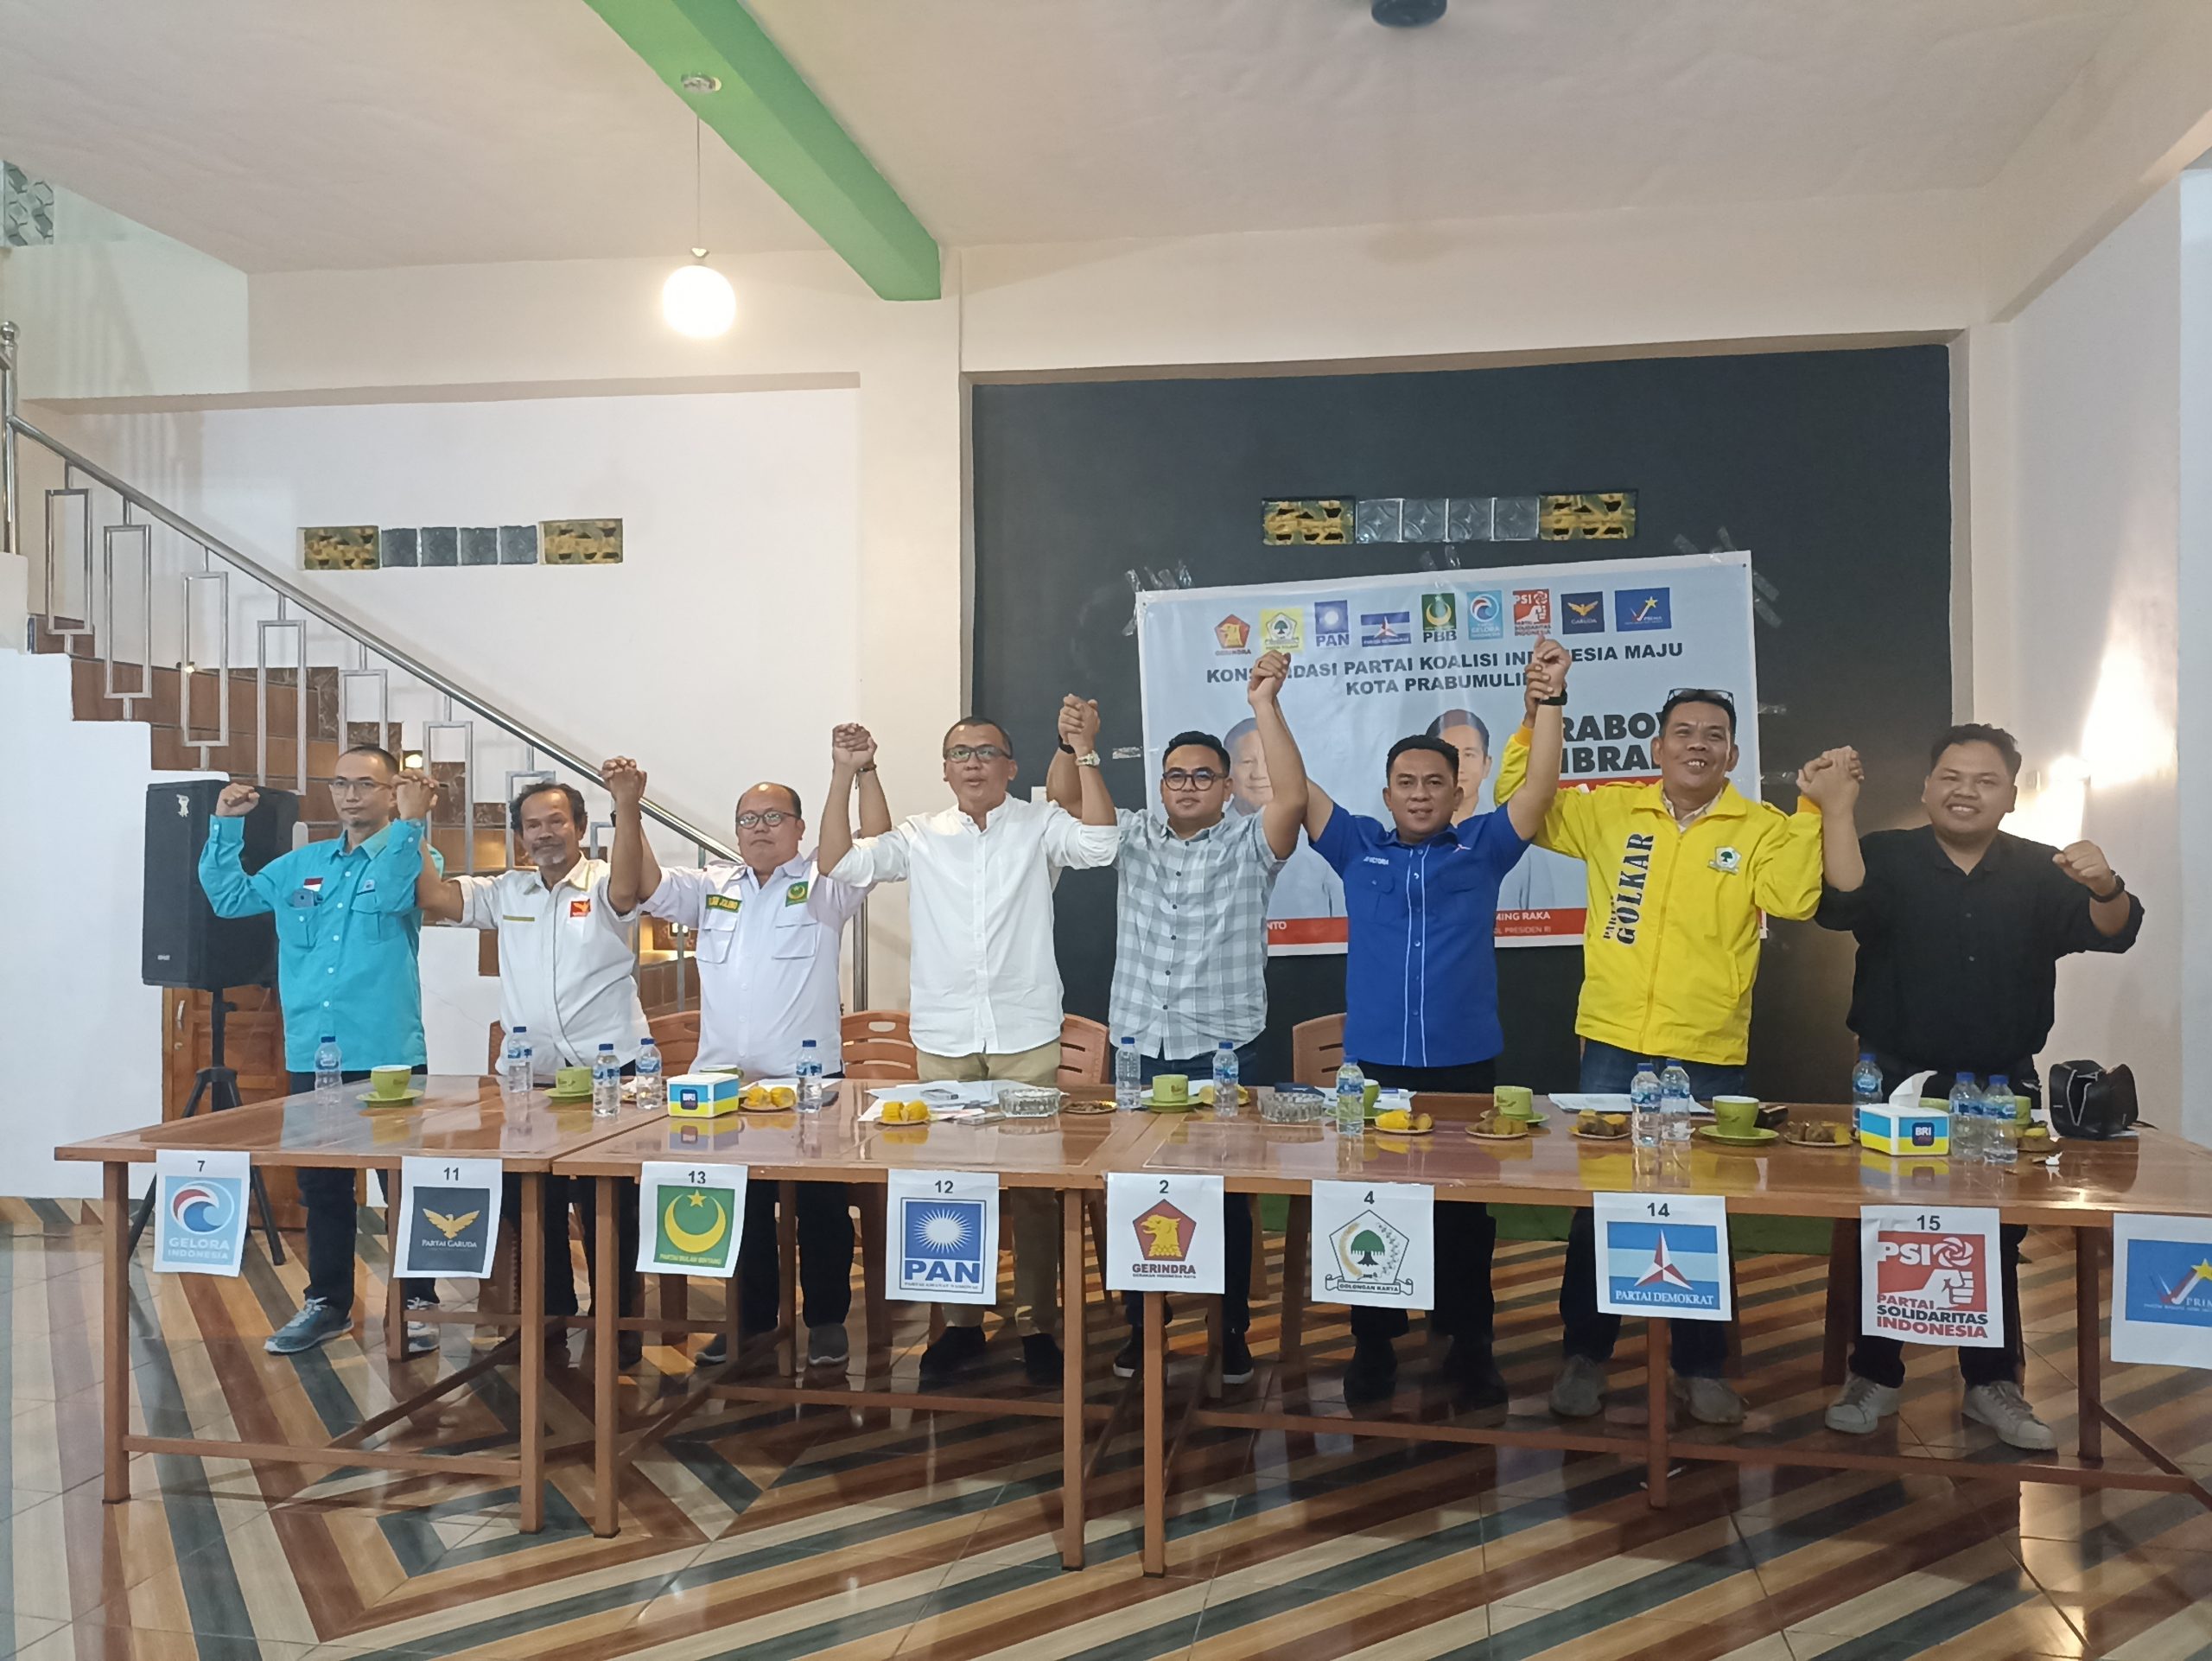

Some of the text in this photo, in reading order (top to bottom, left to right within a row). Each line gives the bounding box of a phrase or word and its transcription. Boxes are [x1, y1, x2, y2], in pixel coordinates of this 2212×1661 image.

[1316, 634, 1350, 647] PAN
[1423, 630, 1458, 643] PBB
[1207, 642, 1683, 684] KONDASI PARTAI KOALISI INESIA MAJU
[1346, 679, 1400, 696] KOTA
[1562, 712, 1662, 742] RABO
[1560, 744, 1662, 774] IBRA
[1617, 833, 1654, 945] GOLKAR
[1522, 911, 1551, 920] RAKA
[1915, 1126, 1932, 1136] BRI
[197, 1160, 206, 1173] 7
[443, 1167, 460, 1181] 11
[689, 1170, 707, 1184] 13
[934, 1180, 954, 1194] 12
[1159, 1179, 1169, 1194] 2
[1363, 1190, 1375, 1205] 4
[1647, 1202, 1670, 1218] 14
[1916, 1214, 1942, 1231] 15
[168, 1237, 230, 1251] GELORA
[168, 1249, 229, 1259] INDONESIA
[1878, 1241, 1931, 1265] PSI
[905, 1259, 981, 1284] PAN
[1132, 1263, 1197, 1275] GERINDRA
[1615, 1289, 1715, 1306] PARTAI DEMOKRAT
[1877, 1295, 1935, 1309] PARTAI
[1877, 1305, 1988, 1325] SOLIDARITAS
[1877, 1316, 1988, 1339] INDONESIA
